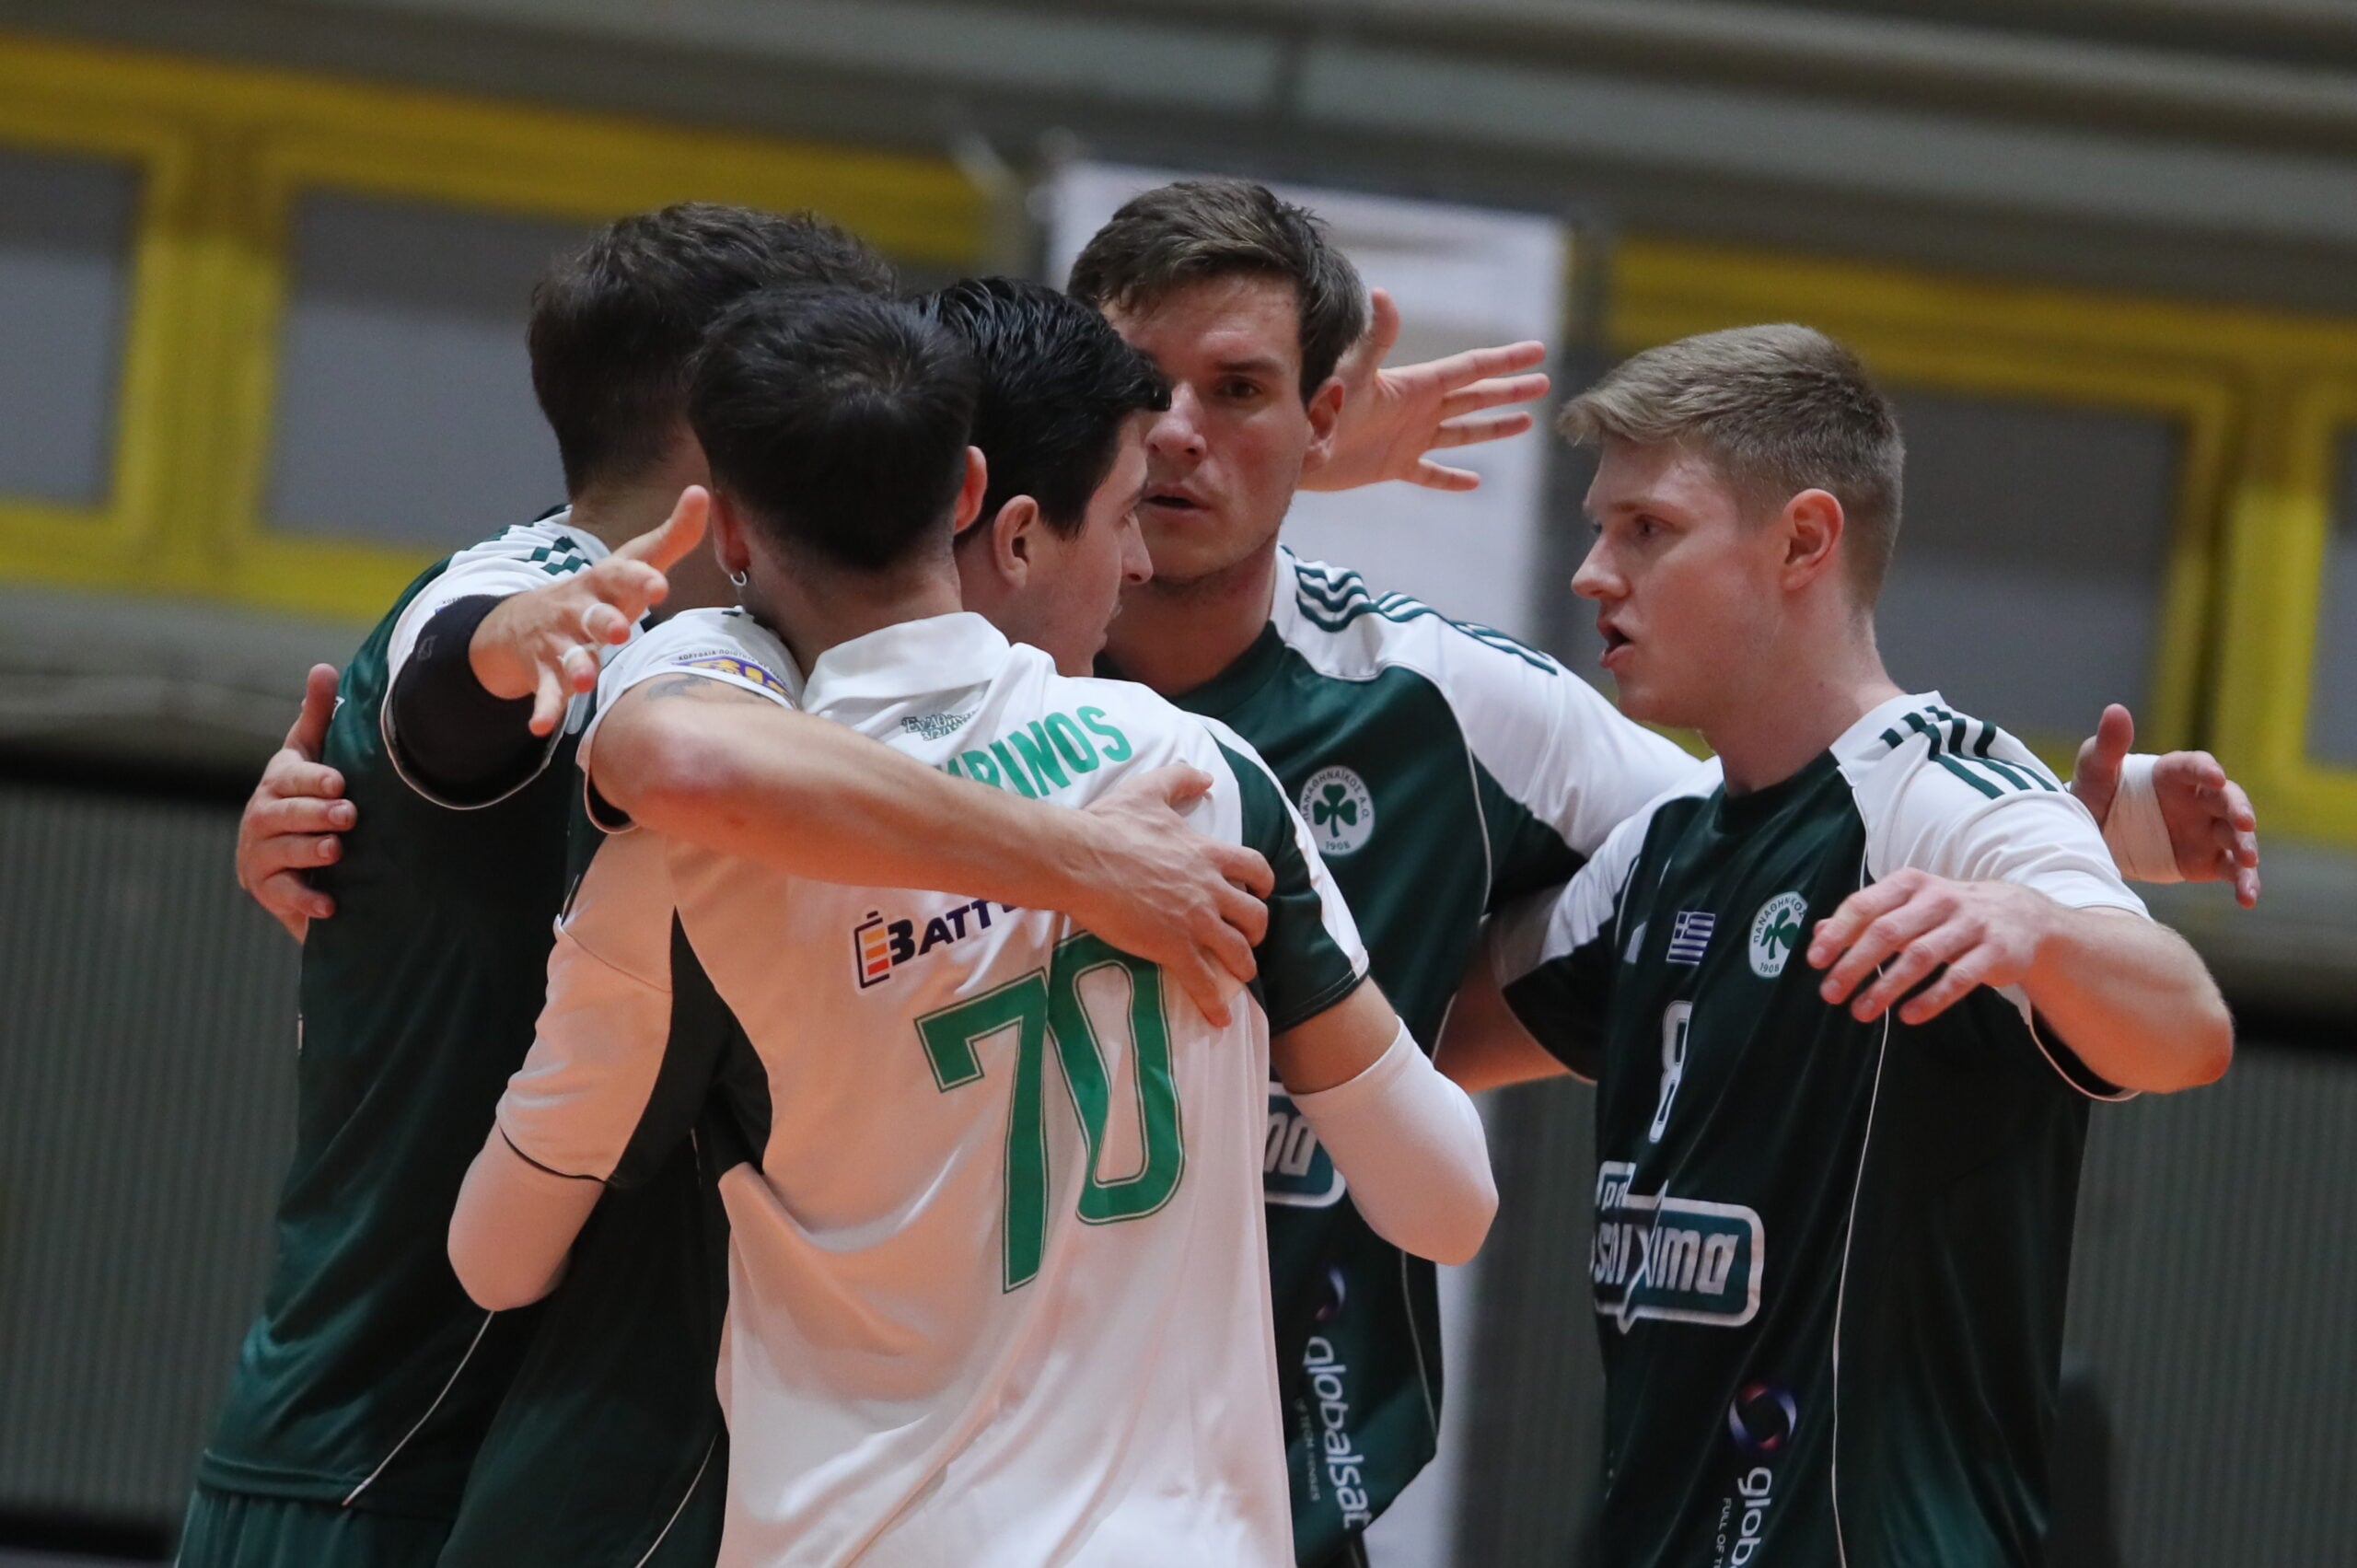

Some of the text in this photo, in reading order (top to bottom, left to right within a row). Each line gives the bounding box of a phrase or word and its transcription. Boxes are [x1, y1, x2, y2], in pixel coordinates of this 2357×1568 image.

[888, 899, 1016, 966] BATT
[914, 930, 1186, 1294] 70
[1729, 1467, 1772, 1567] glob
